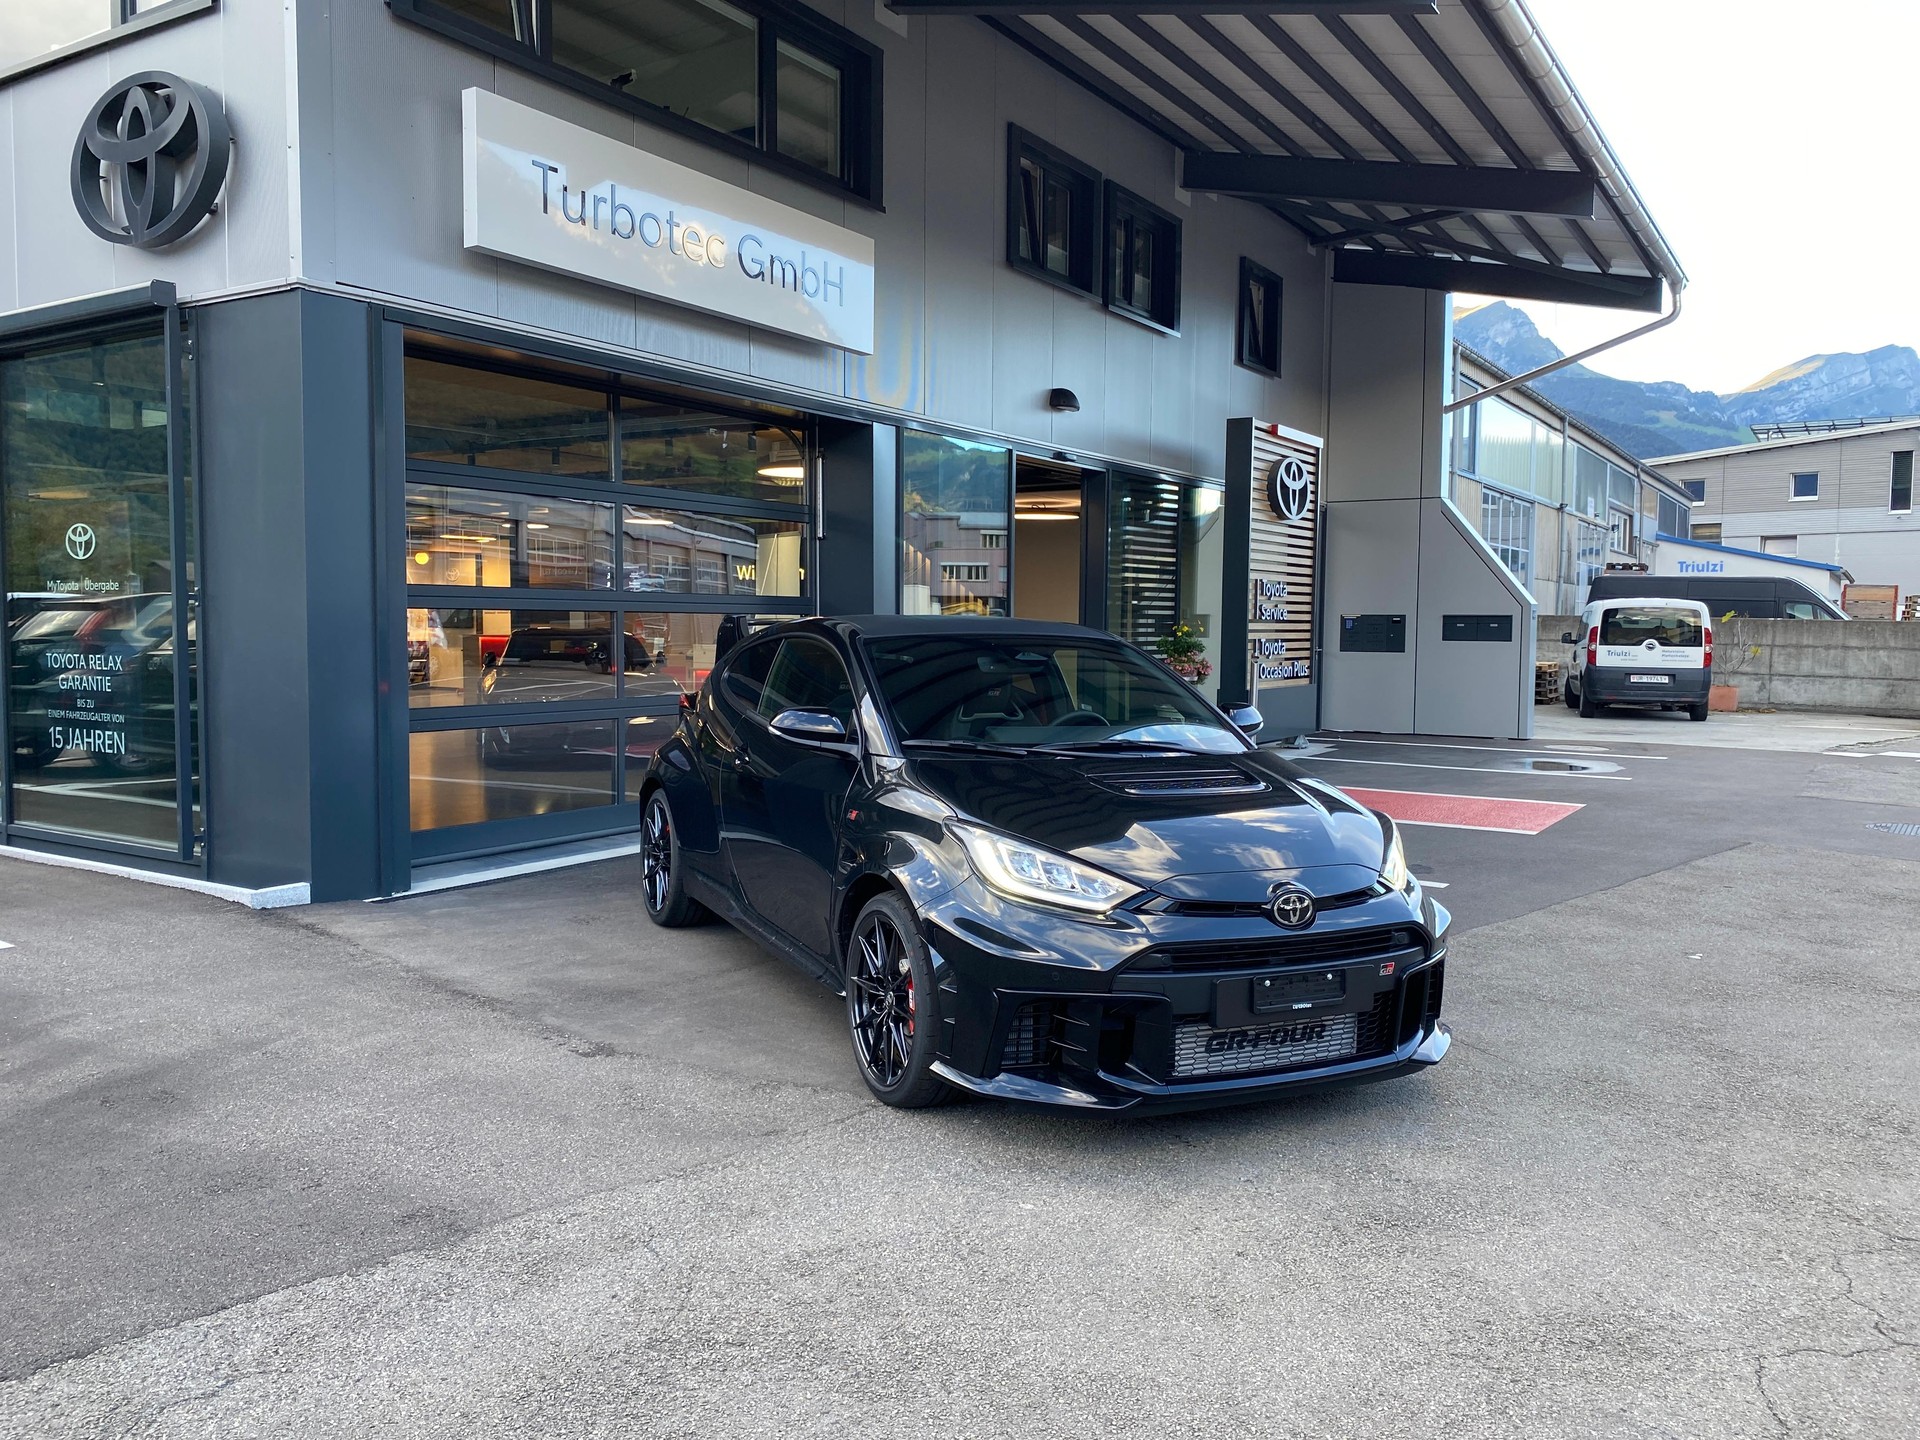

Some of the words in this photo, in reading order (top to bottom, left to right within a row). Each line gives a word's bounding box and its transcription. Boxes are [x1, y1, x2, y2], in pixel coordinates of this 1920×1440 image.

[531, 159, 725, 269] Turbotec
[736, 233, 844, 307] GmbH
[1677, 560, 1724, 573] Triulzi
[46, 580, 79, 594] MyToyota
[84, 577, 119, 593] Übergabe
[1262, 580, 1288, 600] Toyota
[1261, 604, 1288, 620] Service
[1260, 639, 1286, 659] Toyota
[46, 653, 87, 670] TOYOTA
[88, 654, 123, 671] RELAX
[1260, 663, 1293, 679] Occasion
[1293, 661, 1309, 677] Plus
[58, 674, 112, 692] GARANTIE
[77, 699, 86, 708] BIS
[86, 700, 95, 708] ZU
[48, 709, 66, 719] EINEM
[66, 710, 111, 722] FAHRZEUGALTER
[112, 714, 125, 723] VON
[48, 726, 63, 749] 15
[66, 727, 125, 755] JAHREN
[1204, 1023, 1328, 1053] GR-FOUR
